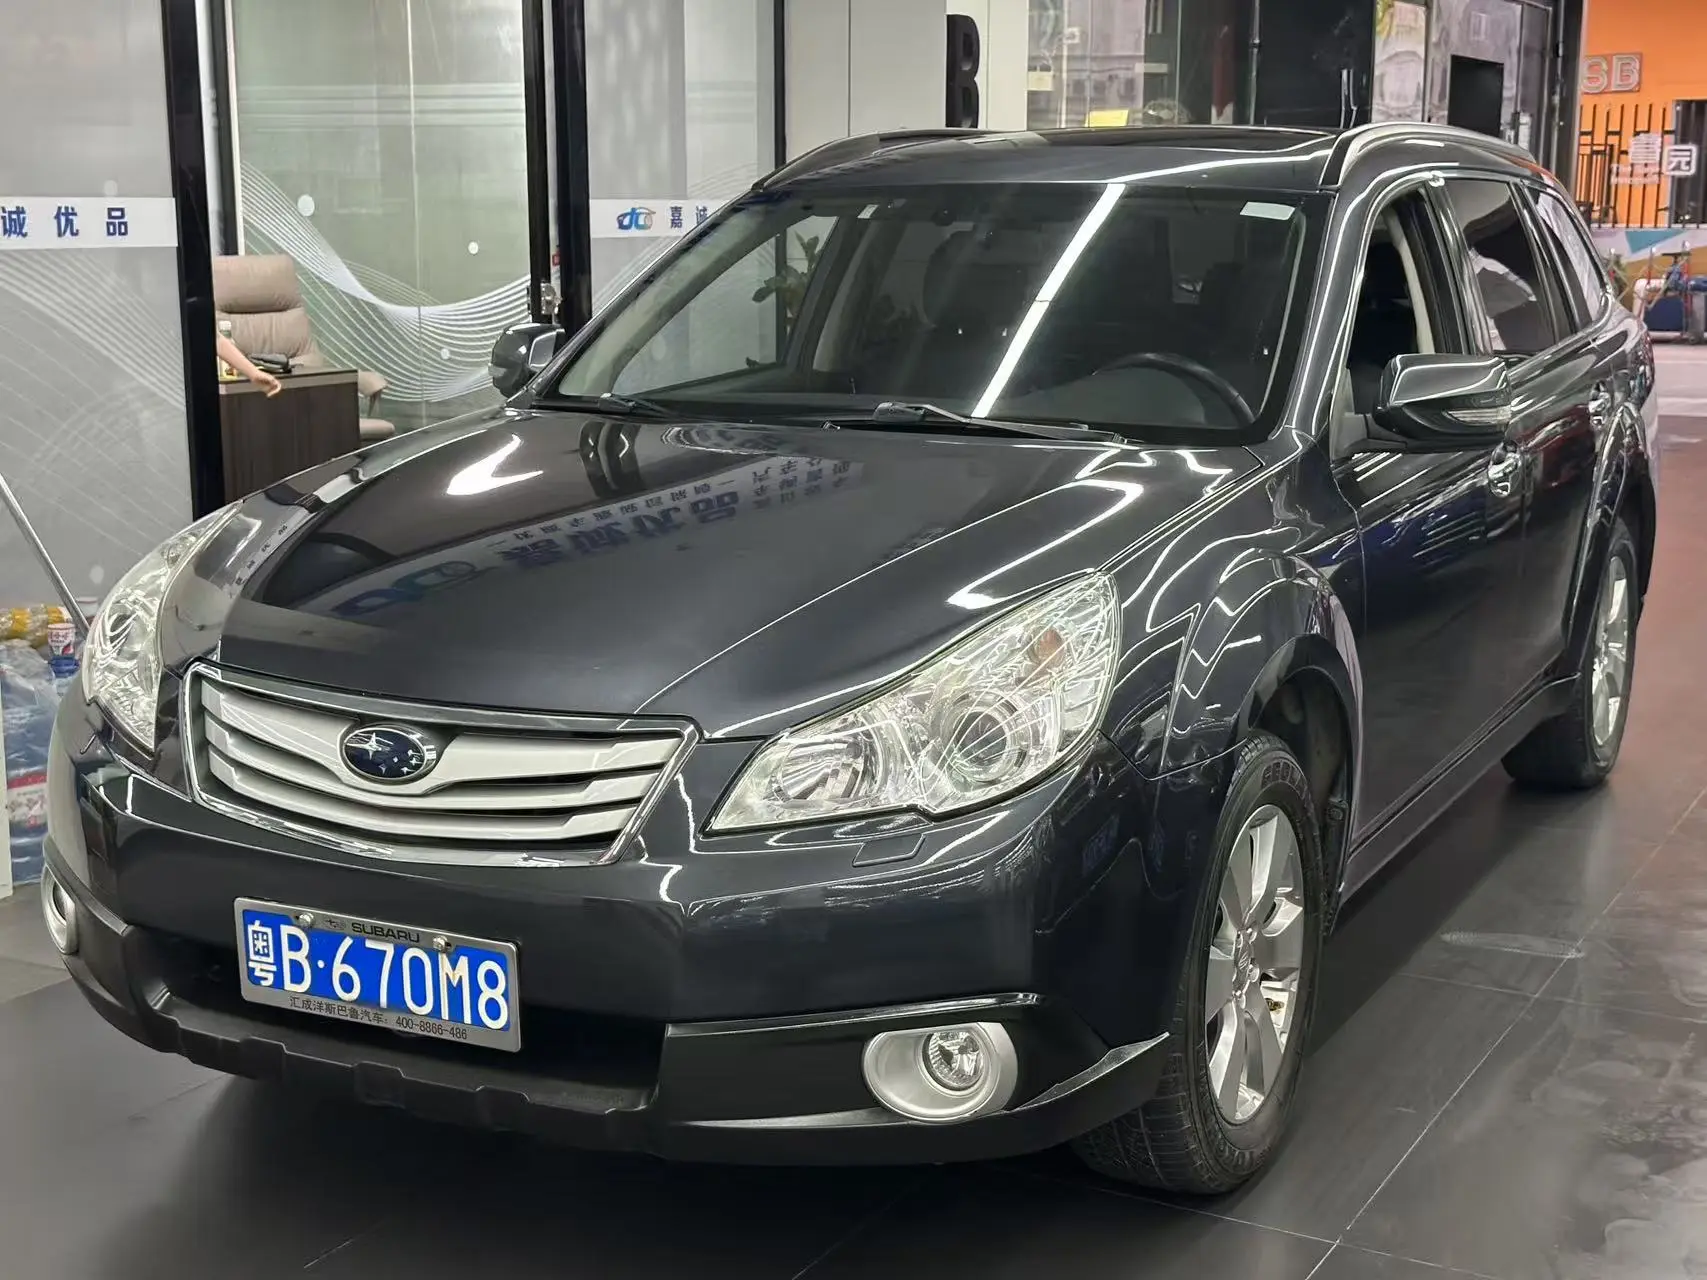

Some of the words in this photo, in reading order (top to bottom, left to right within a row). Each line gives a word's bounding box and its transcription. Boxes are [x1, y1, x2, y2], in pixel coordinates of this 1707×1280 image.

[1, 206, 128, 237] 诚优品
[351, 922, 420, 943] SUBARU
[395, 1015, 468, 1040] 400-8866-486
